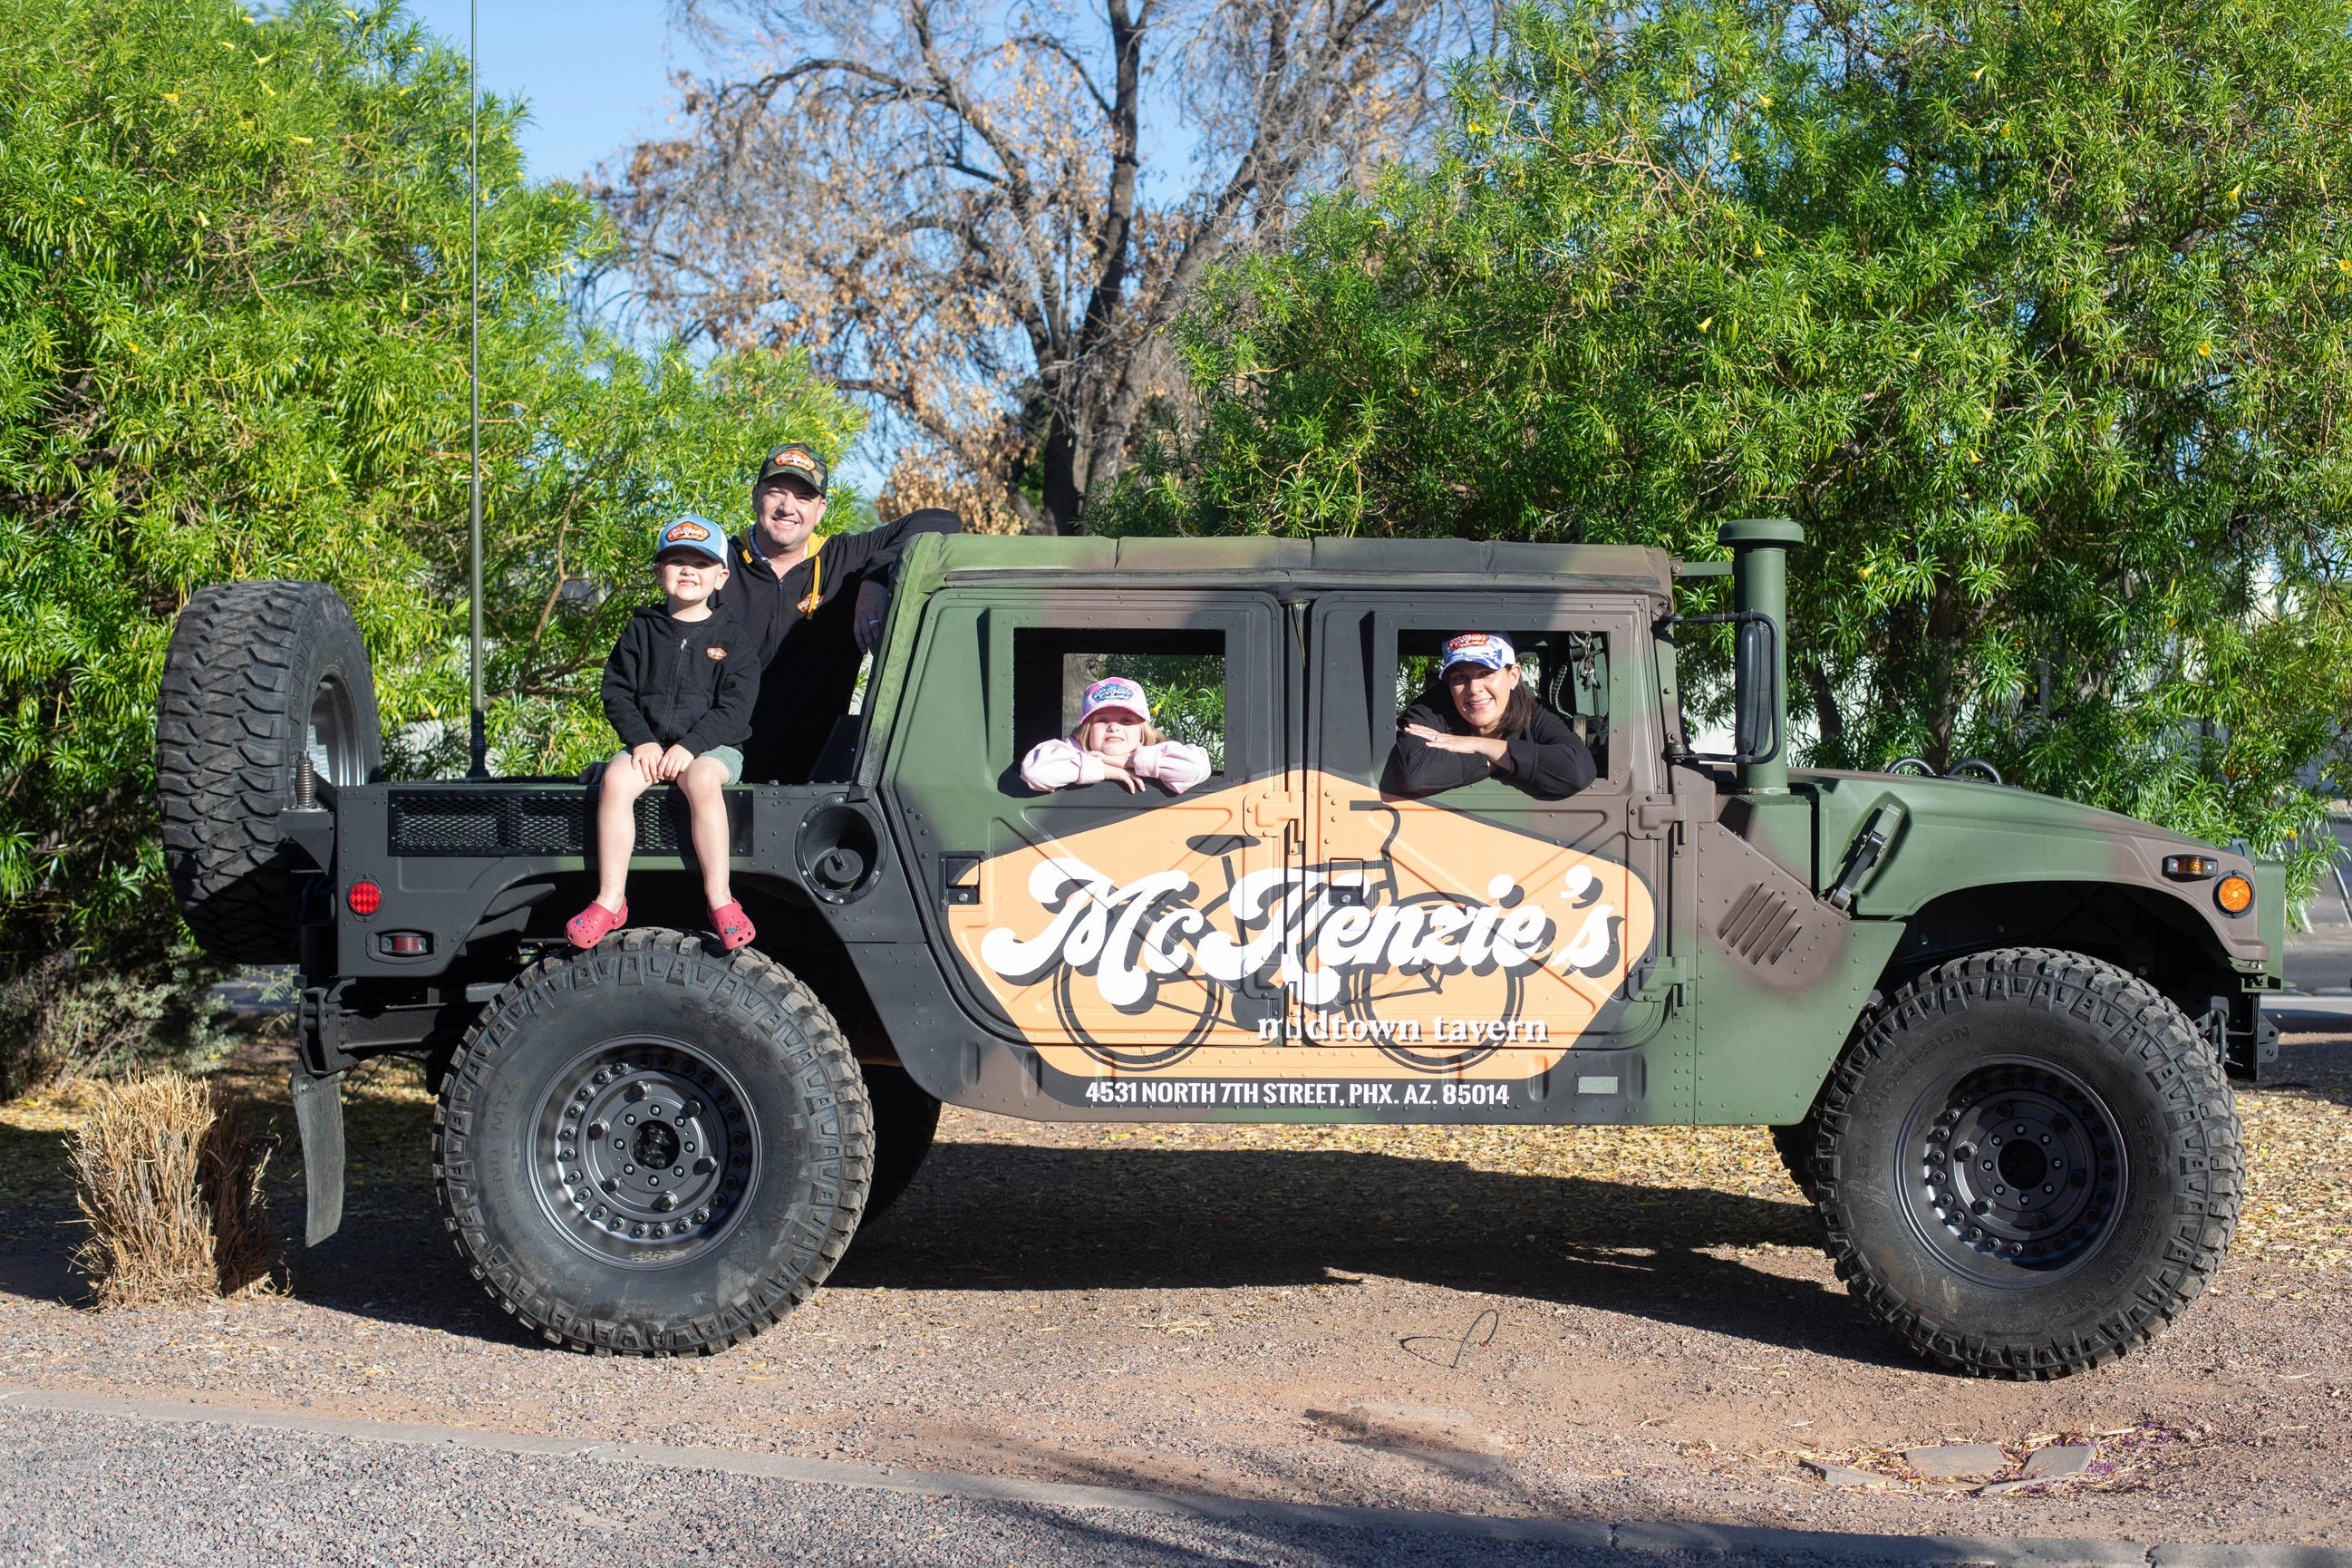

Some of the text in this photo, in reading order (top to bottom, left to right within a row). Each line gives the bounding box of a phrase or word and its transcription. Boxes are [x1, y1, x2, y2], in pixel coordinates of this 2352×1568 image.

[981, 857, 1622, 1007] McKenzie's
[1257, 1009, 1549, 1042] midtown tavern
[1085, 1081, 1510, 1107] 4531 NORTH 7TH STREET, PHX. AZ. 85014
[2135, 1110, 2162, 1181] BAJA
[2105, 1196, 2160, 1287] LEGEND
